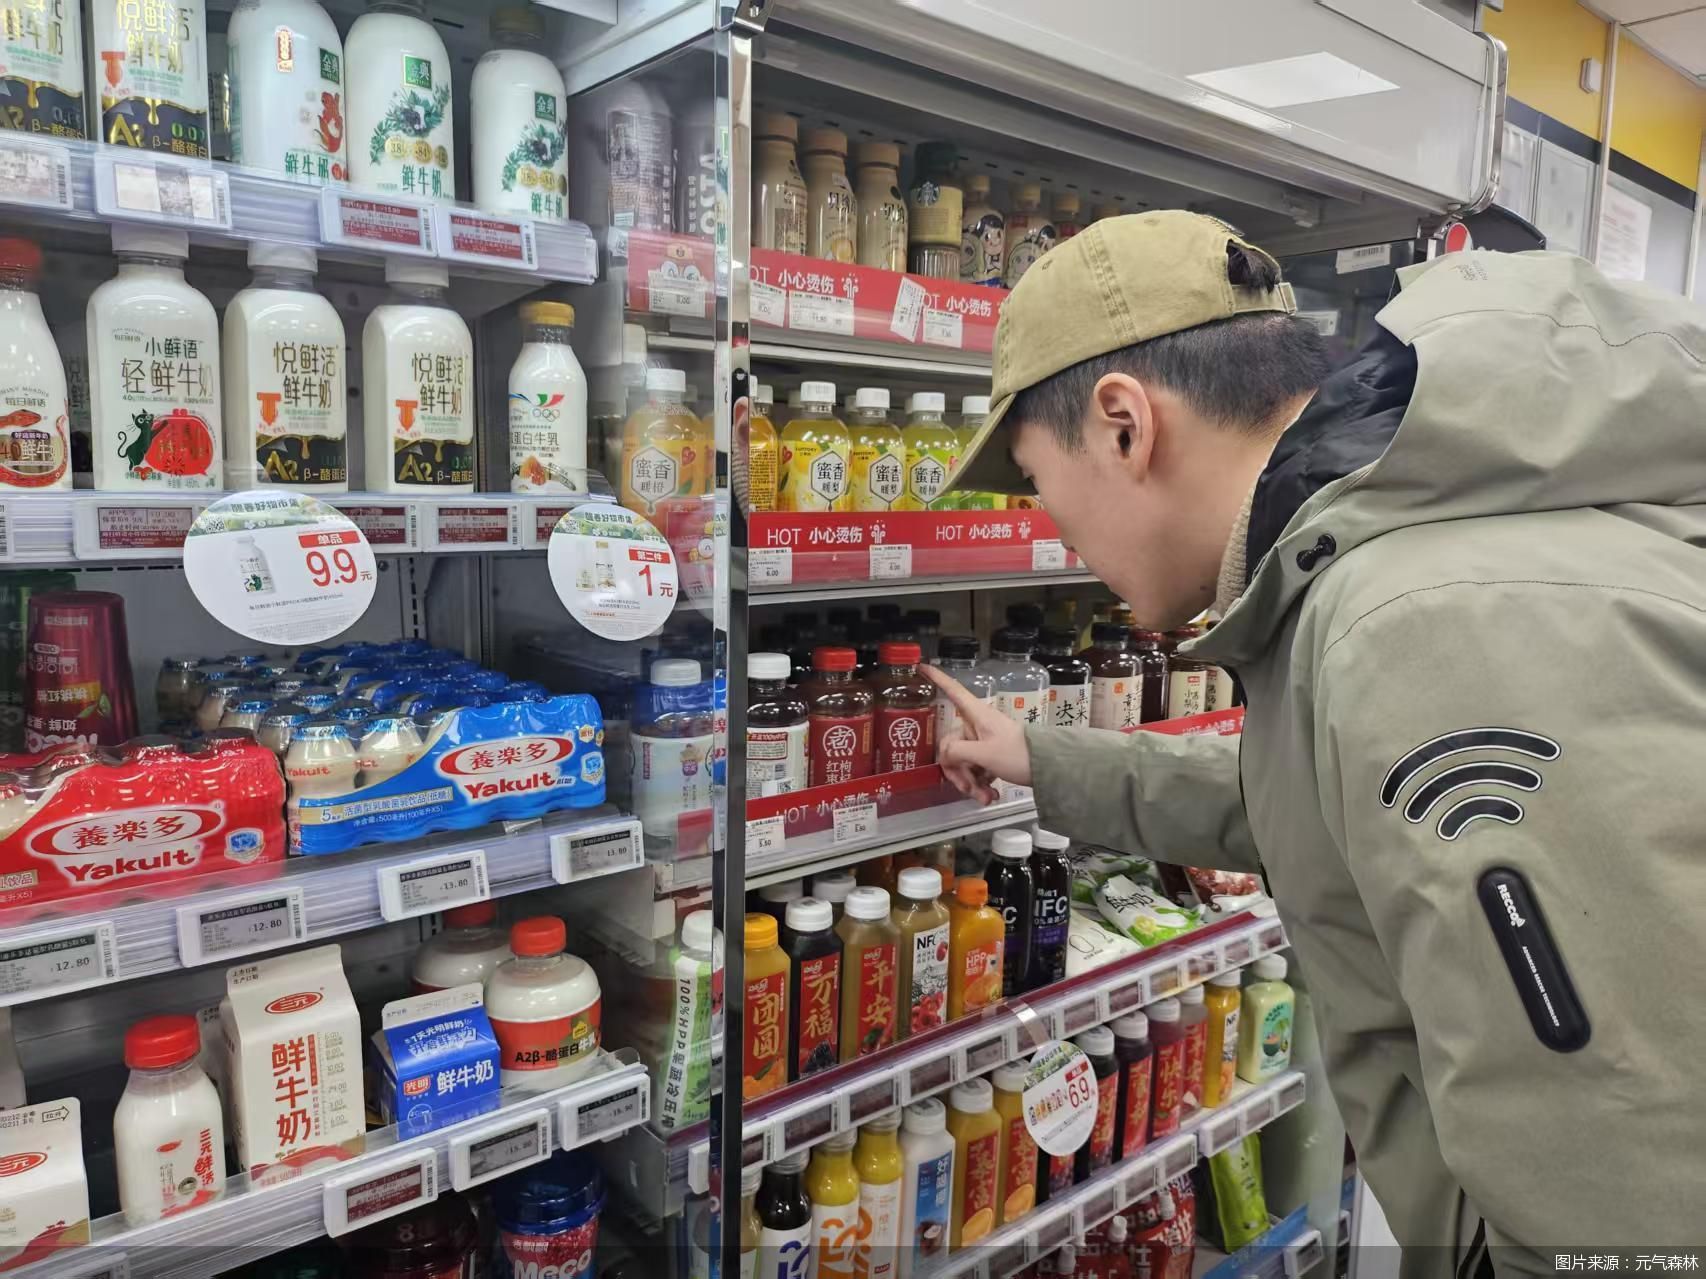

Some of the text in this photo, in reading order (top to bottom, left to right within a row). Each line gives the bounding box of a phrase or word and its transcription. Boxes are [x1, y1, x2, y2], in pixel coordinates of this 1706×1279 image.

[401, 163, 443, 199] 鲜牛奶
[777, 267, 835, 296] 小心烫伤
[946, 295, 992, 317] 小心烫伤
[145, 336, 199, 360] 小鲜语
[273, 340, 336, 377] 悦鲜活
[121, 357, 215, 397] 轻鲜牛奶
[411, 352, 465, 386] 悦鲜活
[282, 374, 333, 409] 鲜牛奶
[419, 384, 463, 416] 鲜牛奶
[635, 457, 672, 480] 蜜香
[817, 461, 844, 481] 蜜香
[875, 464, 901, 483] 蜜香
[914, 465, 943, 485] 蜜香
[317, 532, 344, 546] 单品
[766, 526, 864, 547] HOT 小心烫伤
[935, 523, 1014, 542] HOT 小心烫伤
[305, 548, 359, 588] 9.9
[359, 569, 373, 582] 元
[638, 565, 653, 597] 1
[659, 582, 674, 598] 元
[470, 742, 548, 771] 養楽多
[463, 771, 556, 800] Yakult
[775, 804, 809, 825] HOT
[71, 814, 188, 850] 養楽多
[63, 849, 196, 883] Yakult
[1033, 895, 1068, 918] IFC
[1497, 883, 1520, 924] RECCO
[253, 918, 283, 933] 12.80
[55, 956, 90, 972] 12.80
[279, 995, 308, 1011] 三元
[405, 1077, 430, 1093] 光明
[436, 1059, 494, 1096] 鲜牛奶
[271, 1036, 311, 1148] 鲜牛奶
[1067, 1076, 1090, 1109] 6.9
